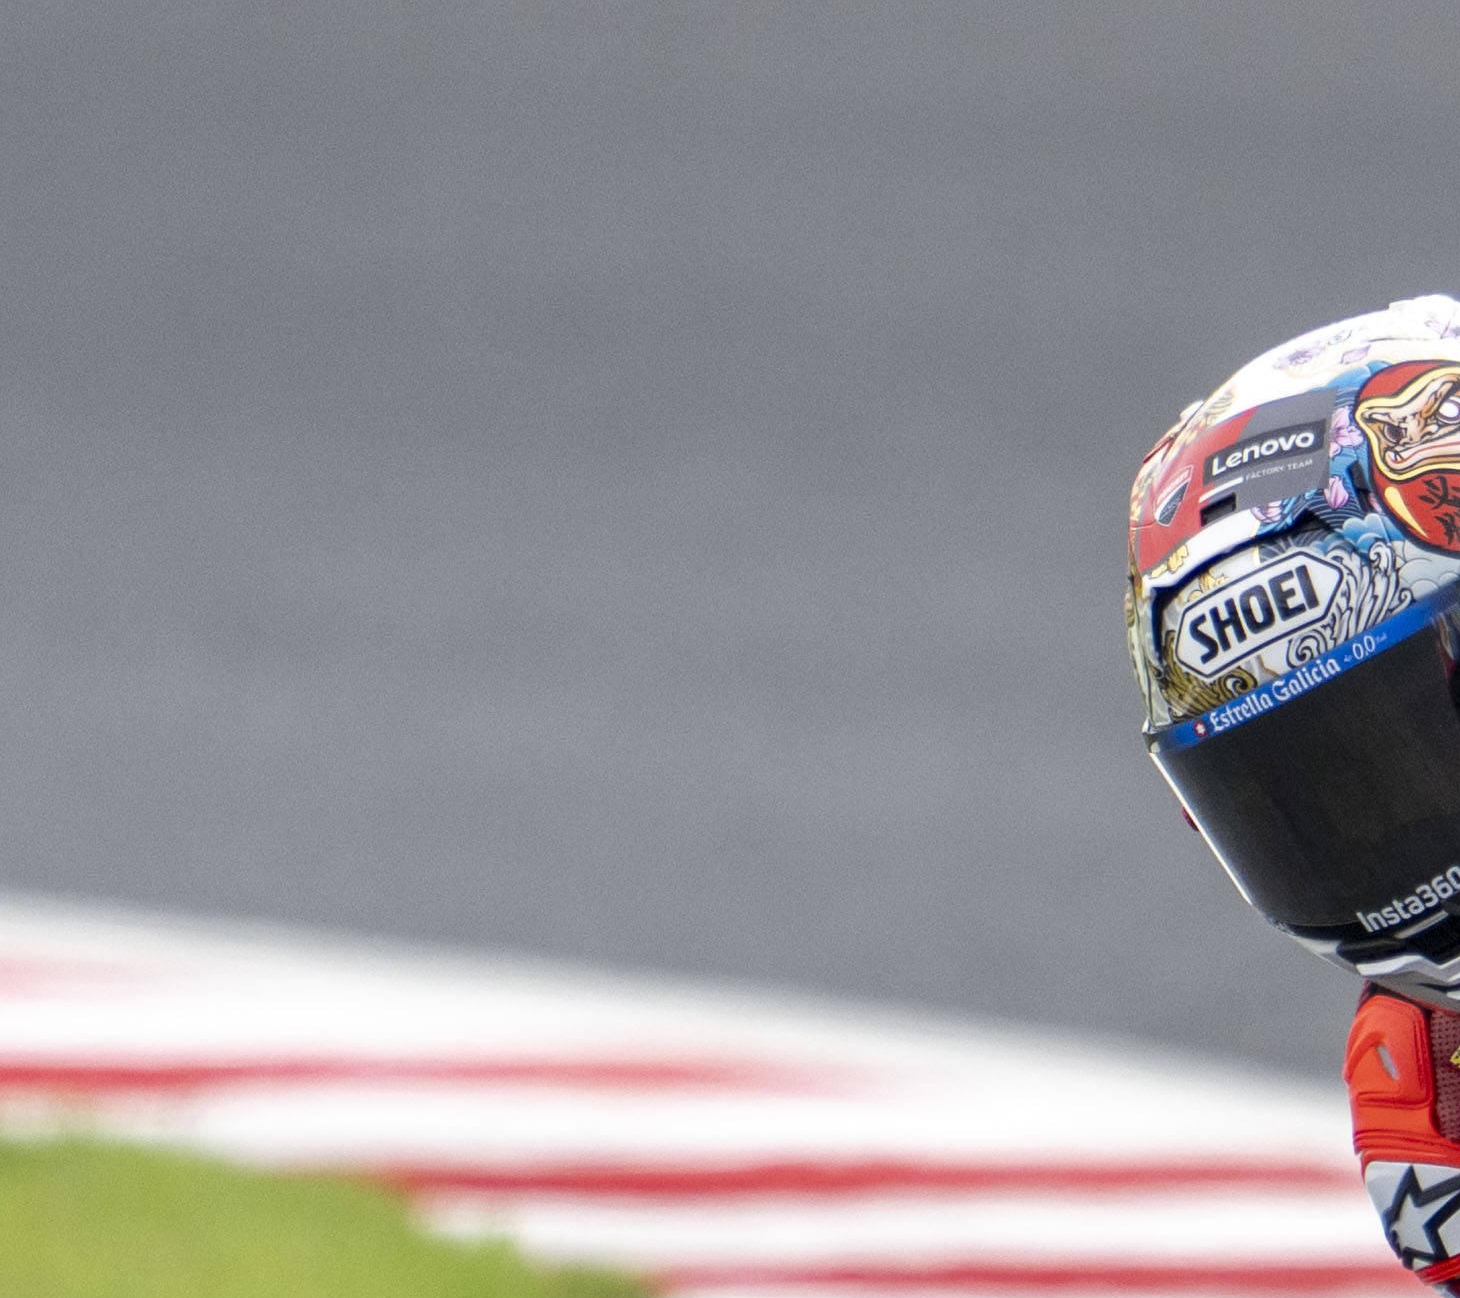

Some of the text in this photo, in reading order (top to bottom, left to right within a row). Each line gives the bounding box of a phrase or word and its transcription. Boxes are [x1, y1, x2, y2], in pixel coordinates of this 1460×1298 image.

[1210, 431, 1315, 476] Lenovo
[1246, 459, 1314, 481] FACTORY TEAM
[1189, 564, 1320, 665] SHOEI
[1209, 691, 1274, 733] Estrella
[1272, 657, 1341, 701] Galicia
